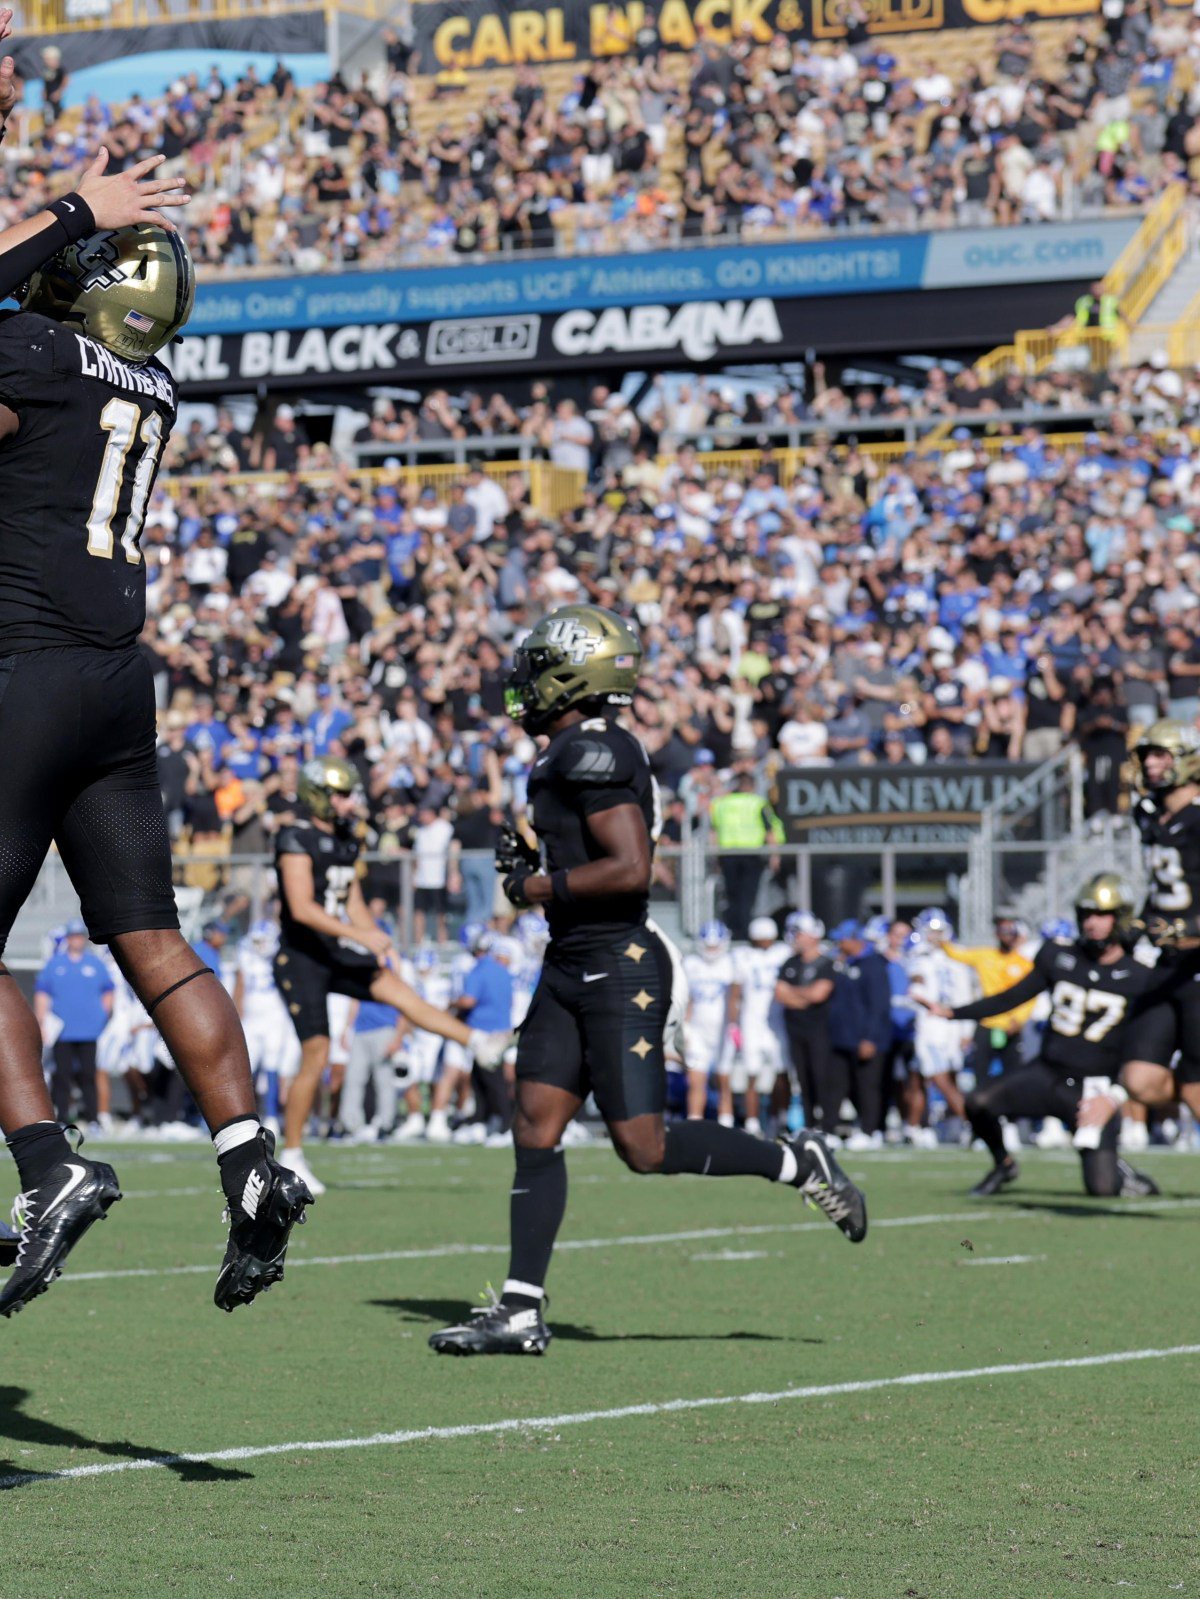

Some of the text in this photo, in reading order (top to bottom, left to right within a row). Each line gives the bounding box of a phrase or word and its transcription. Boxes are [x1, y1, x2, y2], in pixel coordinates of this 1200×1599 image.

[433, 8, 576, 67] CARL
[306, 284, 402, 321] proudly
[406, 278, 519, 313] supports
[716, 259, 762, 288] GO
[765, 249, 901, 286] KNIGHTS!
[963, 236, 1104, 269] ouc.com
[238, 323, 399, 378] BLACK
[396, 328, 421, 359] &
[435, 323, 528, 356] GOLD
[551, 297, 783, 361] CABANA
[546, 617, 604, 666] UCF
[786, 778, 873, 816] DAN
[241, 1169, 266, 1221] NIKE
